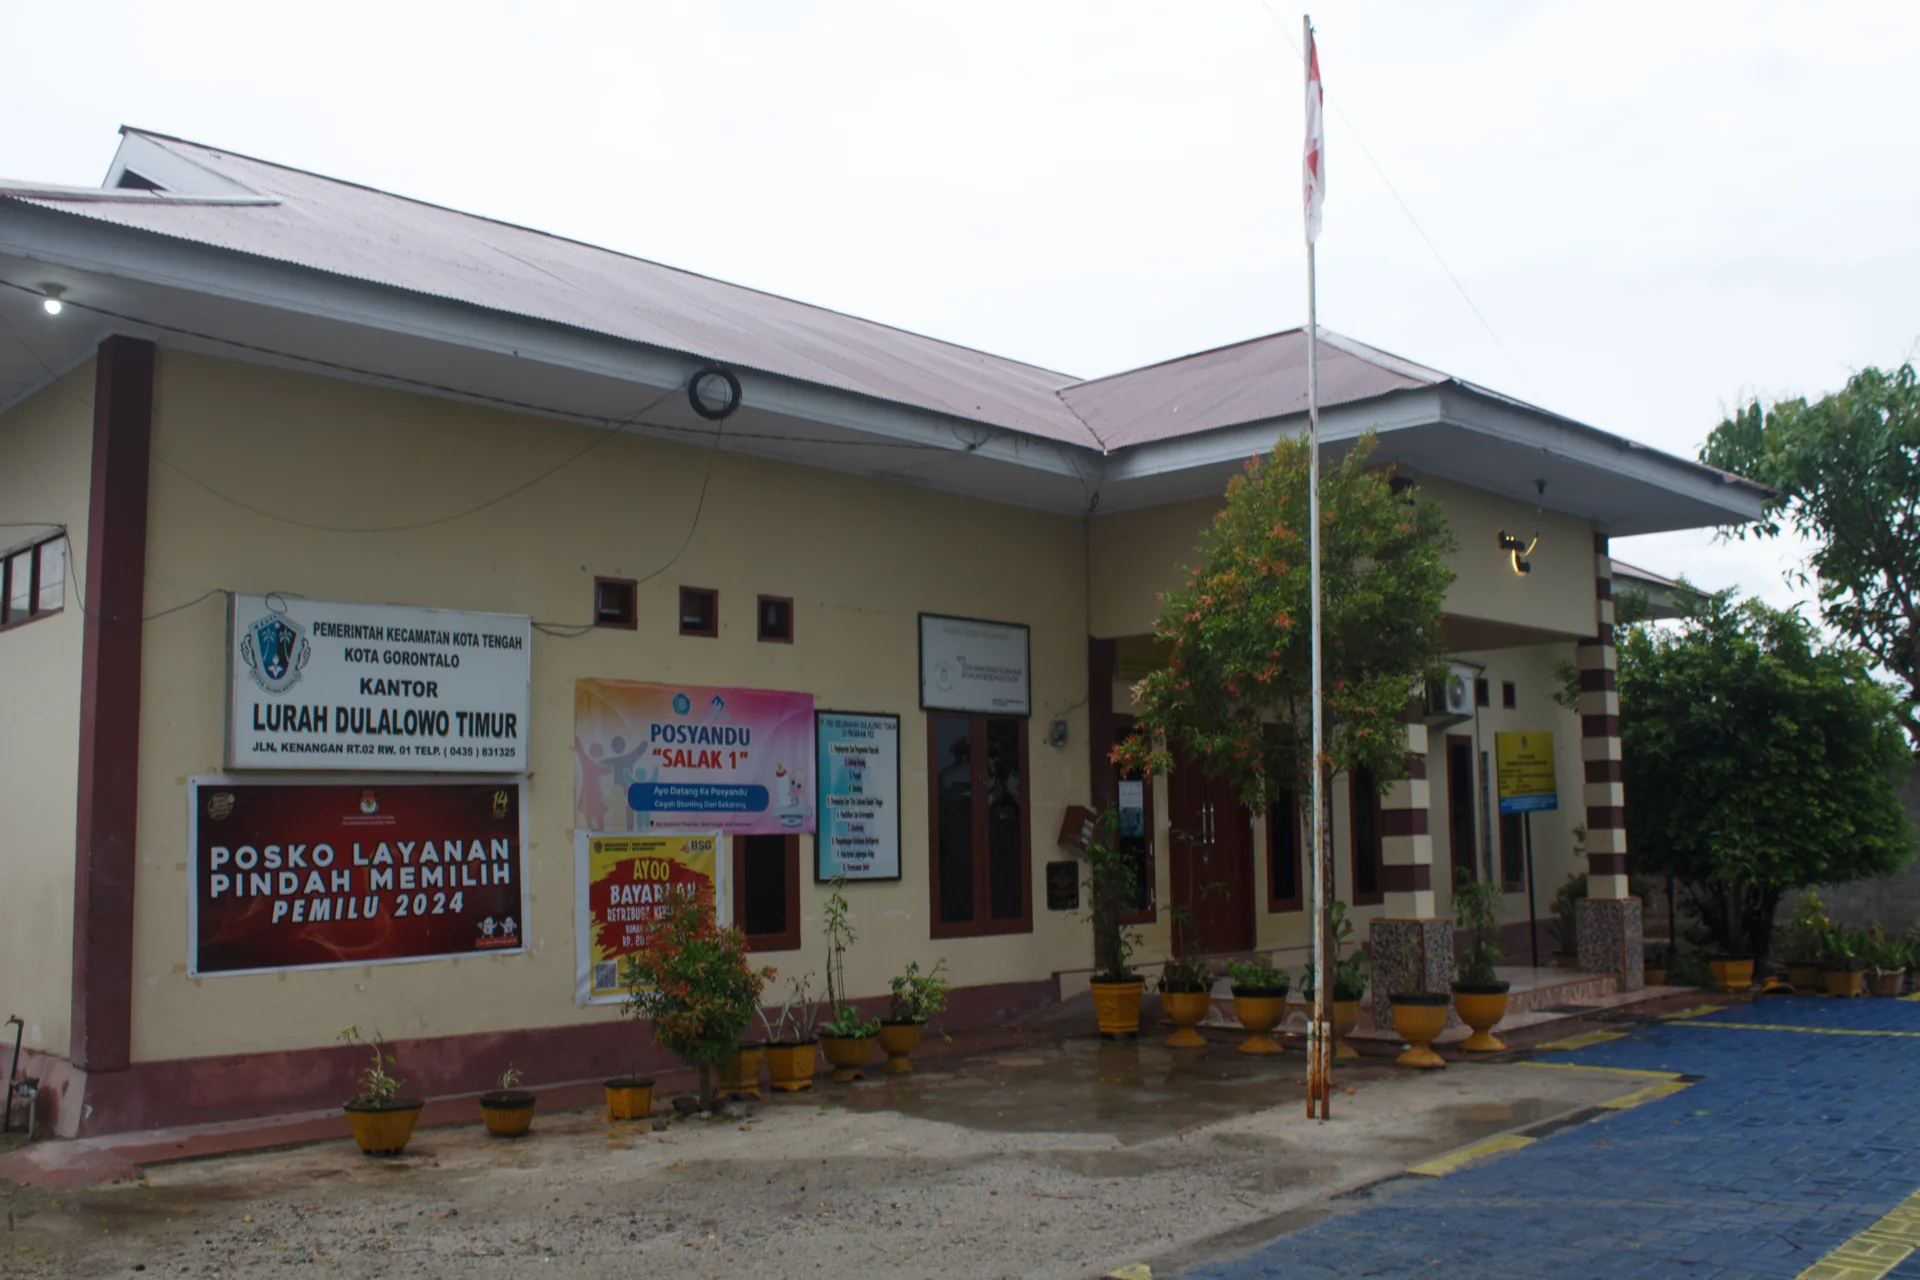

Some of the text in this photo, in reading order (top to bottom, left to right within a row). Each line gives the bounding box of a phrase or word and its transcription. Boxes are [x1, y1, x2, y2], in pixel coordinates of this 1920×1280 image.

[313, 621, 522, 650] PEMERINTAH KECAMATAN KOTA TENGAH
[344, 648, 460, 668] KOTA GORONTALO
[360, 678, 438, 699] KANTOR
[253, 703, 518, 739] LURAH DULALOWO TIMUR
[650, 723, 750, 746] POSYANDU
[252, 742, 277, 753] JLN.
[281, 742, 344, 754] KENANGAN
[346, 744, 374, 755] RT.02
[378, 745, 396, 756] RW.
[399, 745, 411, 756] 01
[415, 746, 440, 756] TELP.
[450, 746, 473, 757] 0435
[482, 747, 516, 757] 831325
[653, 748, 723, 769] "SALAK
[653, 786, 747, 798] Ayo Datang Ke Posyandu
[655, 800, 746, 810] Cegah Stunting Dari Sekarang
[211, 838, 509, 871] POSKO LAYANAN
[691, 841, 711, 850] BSG
[211, 863, 510, 898] PINDAH MEMILIH
[633, 859, 670, 881] AYOO
[271, 891, 464, 924] PEMILU 2024
